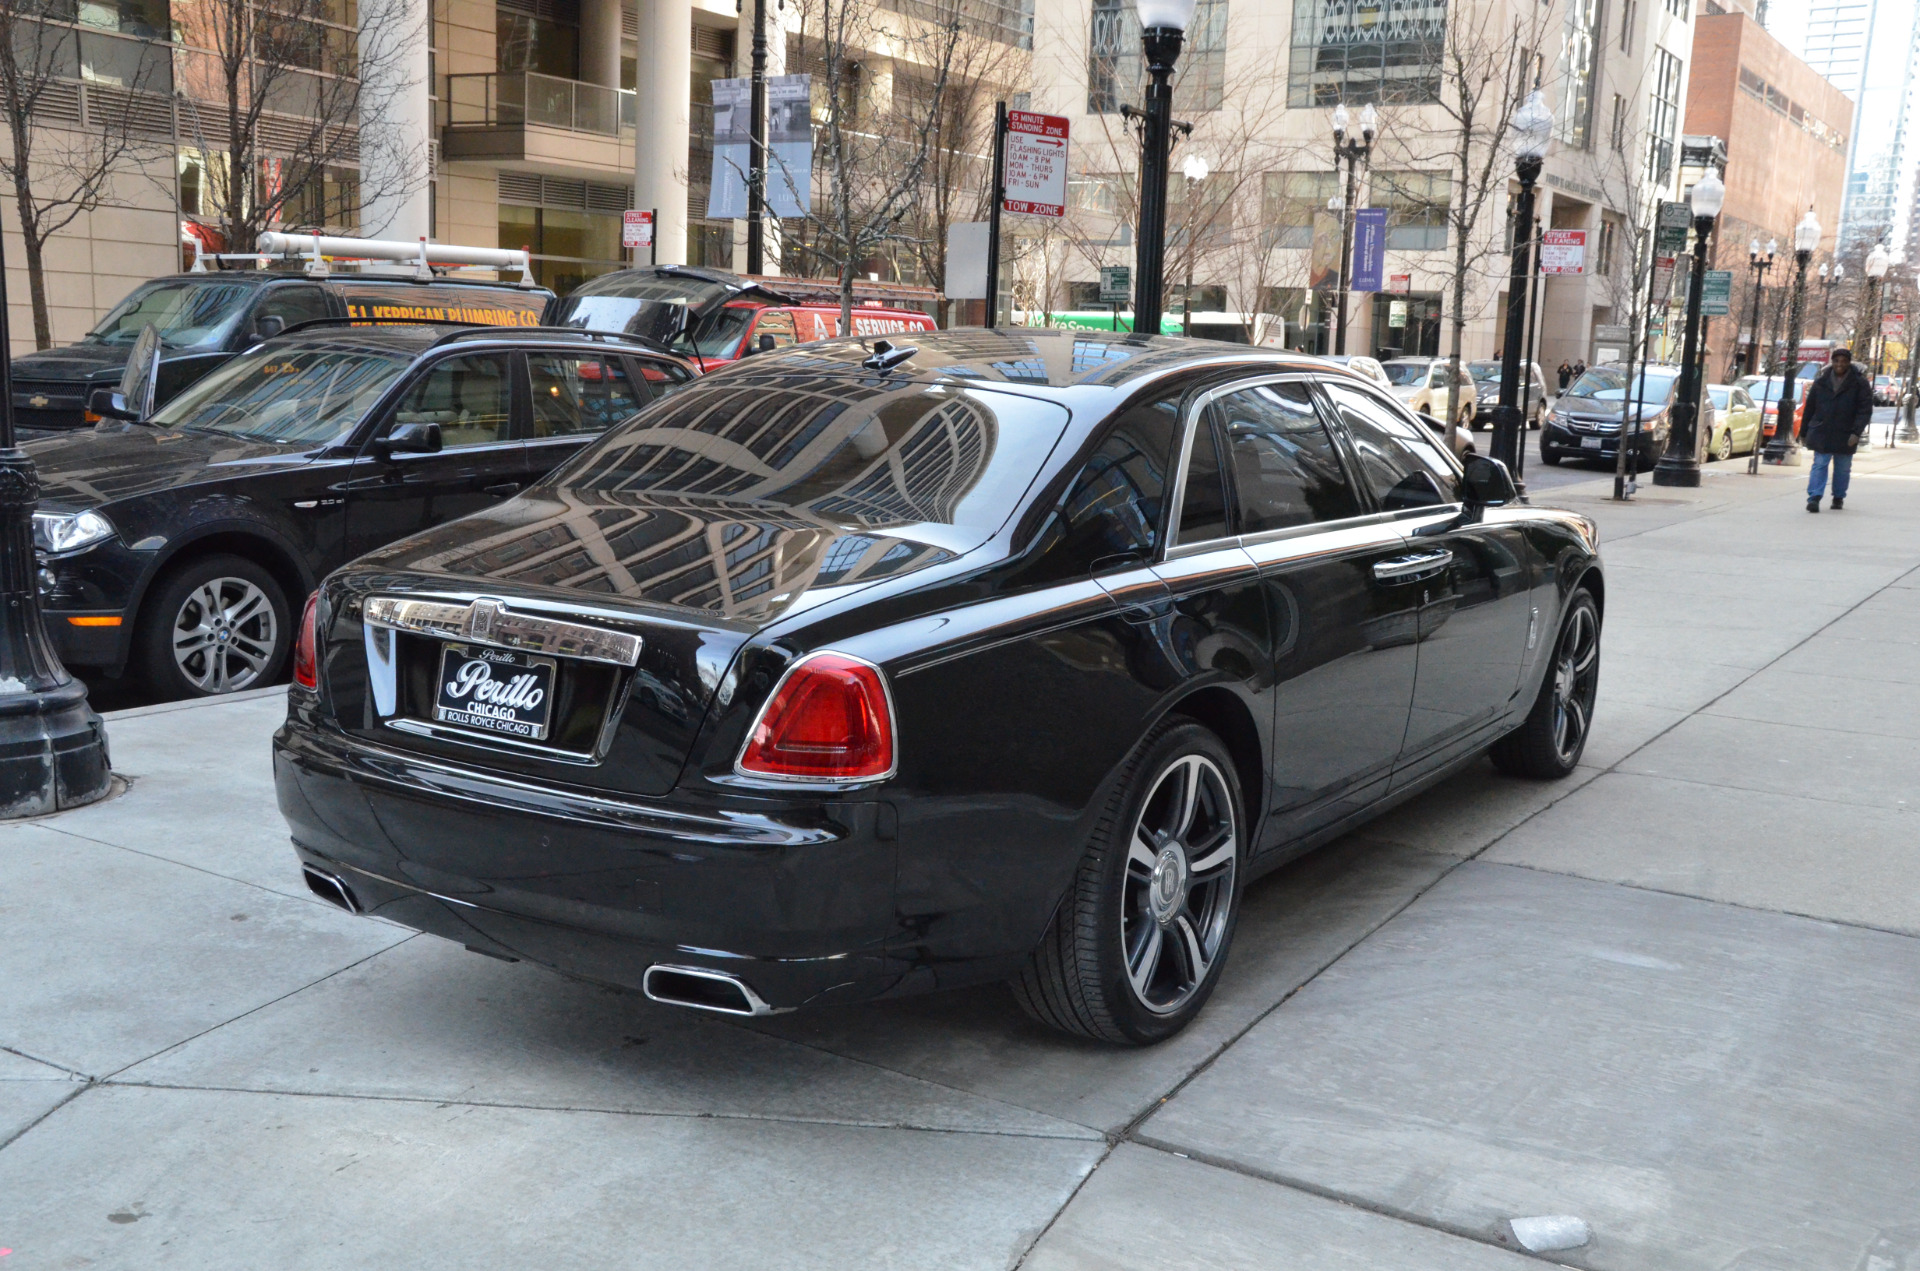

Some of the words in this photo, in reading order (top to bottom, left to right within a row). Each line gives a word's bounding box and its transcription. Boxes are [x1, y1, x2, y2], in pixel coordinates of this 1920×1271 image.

[1020, 114, 1044, 124] MINUTE
[1011, 122, 1043, 133] STANDING
[1046, 126, 1063, 136] ZONE
[1010, 135, 1023, 143] USE
[1010, 144, 1041, 155] FLASHING
[1042, 148, 1065, 158] LIGHTS
[1010, 152, 1017, 160] 10
[1018, 153, 1028, 161] AM
[1009, 161, 1024, 169] MON
[1031, 164, 1053, 173] THURS
[1008, 178, 1019, 186] FRI
[1025, 180, 1040, 189] SUN
[1039, 174, 1049, 182] PM
[1007, 200, 1029, 212] TOW
[1033, 203, 1059, 216] ZONE
[447, 308, 518, 327] PLUMBING
[856, 318, 906, 336] SERVICE
[479, 649, 516, 663] Perillo
[446, 660, 543, 710] Perillo
[467, 701, 516, 720] CHICAGO
[447, 711, 469, 723] ROLLS
[470, 716, 496, 728] ROYCE
[496, 720, 529, 735] CHICAGO
